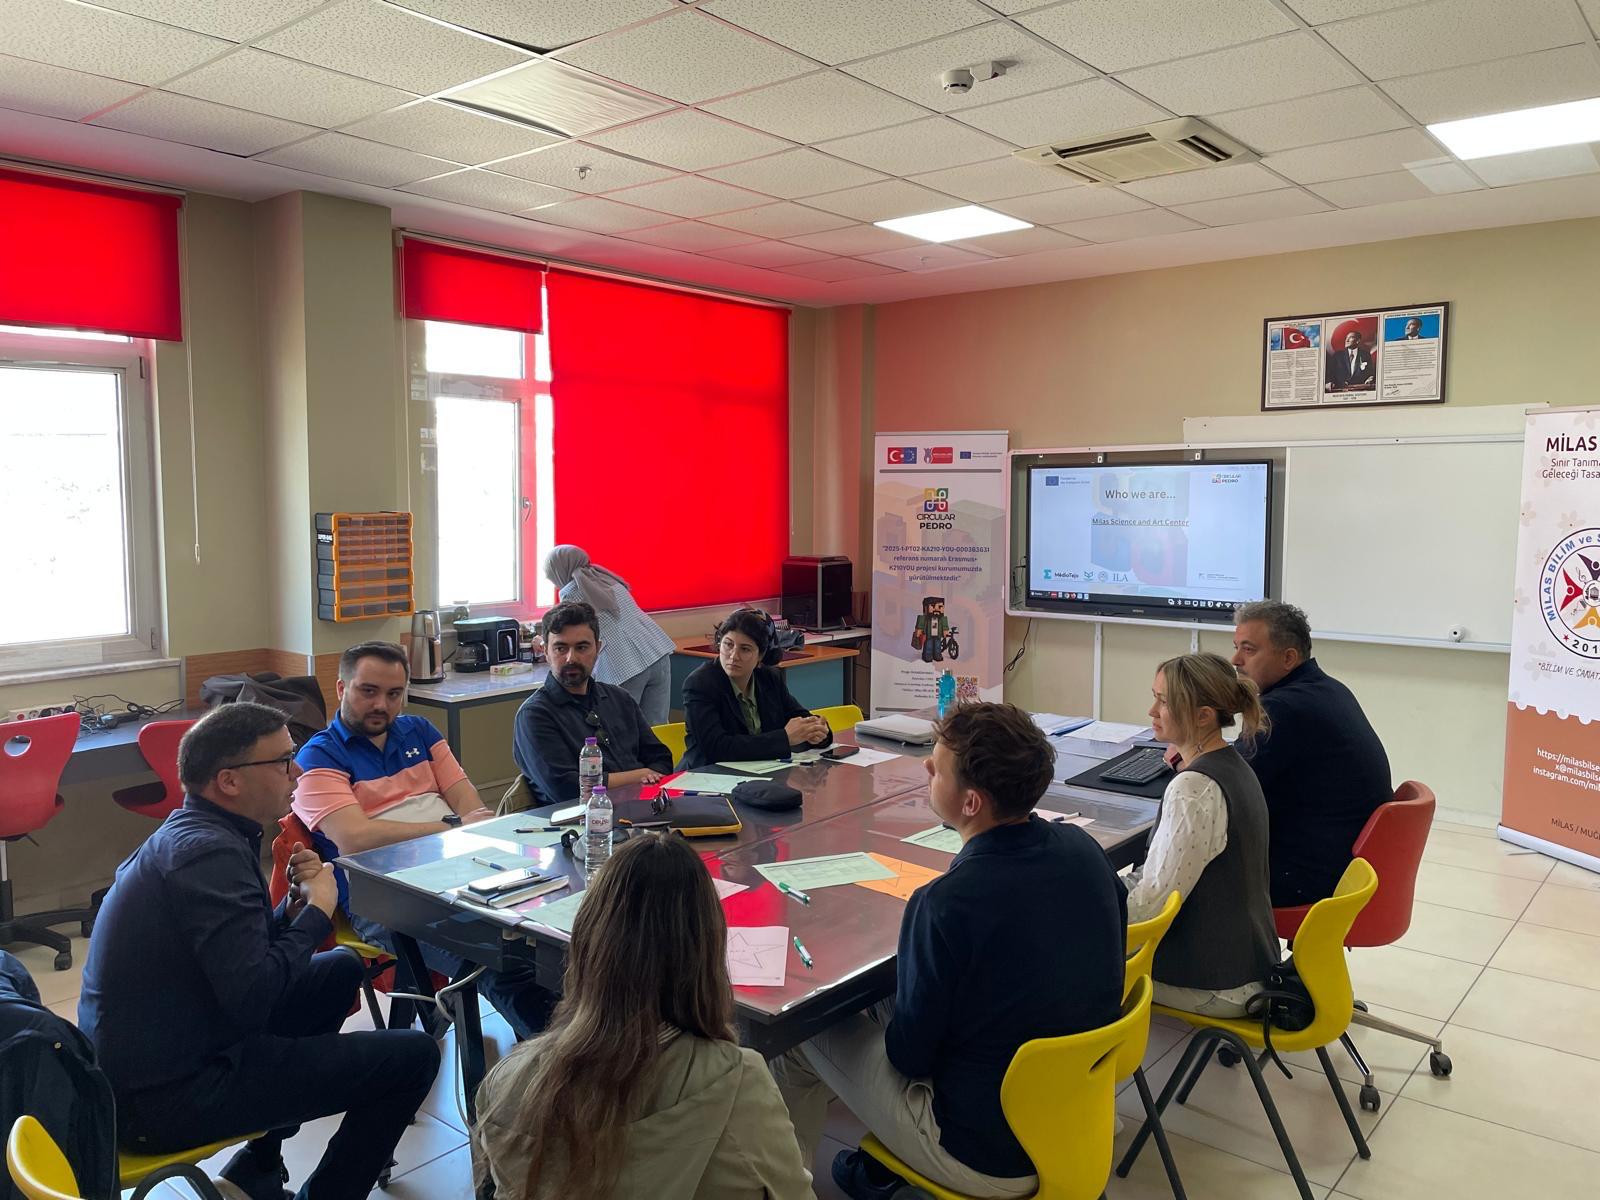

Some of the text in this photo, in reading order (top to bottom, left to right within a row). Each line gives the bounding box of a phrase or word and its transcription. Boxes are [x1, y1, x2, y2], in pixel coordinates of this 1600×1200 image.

[1546, 433, 1597, 452] MİLAS
[1551, 458, 1570, 467] Sınır
[1542, 469, 1579, 480] Geleceği
[1105, 489, 1176, 499] Who we are...
[916, 513, 956, 521] CIRCULAR
[919, 522, 953, 530] PEDRO
[1578, 535, 1592, 545] ve
[1113, 573, 1129, 582] ILA
